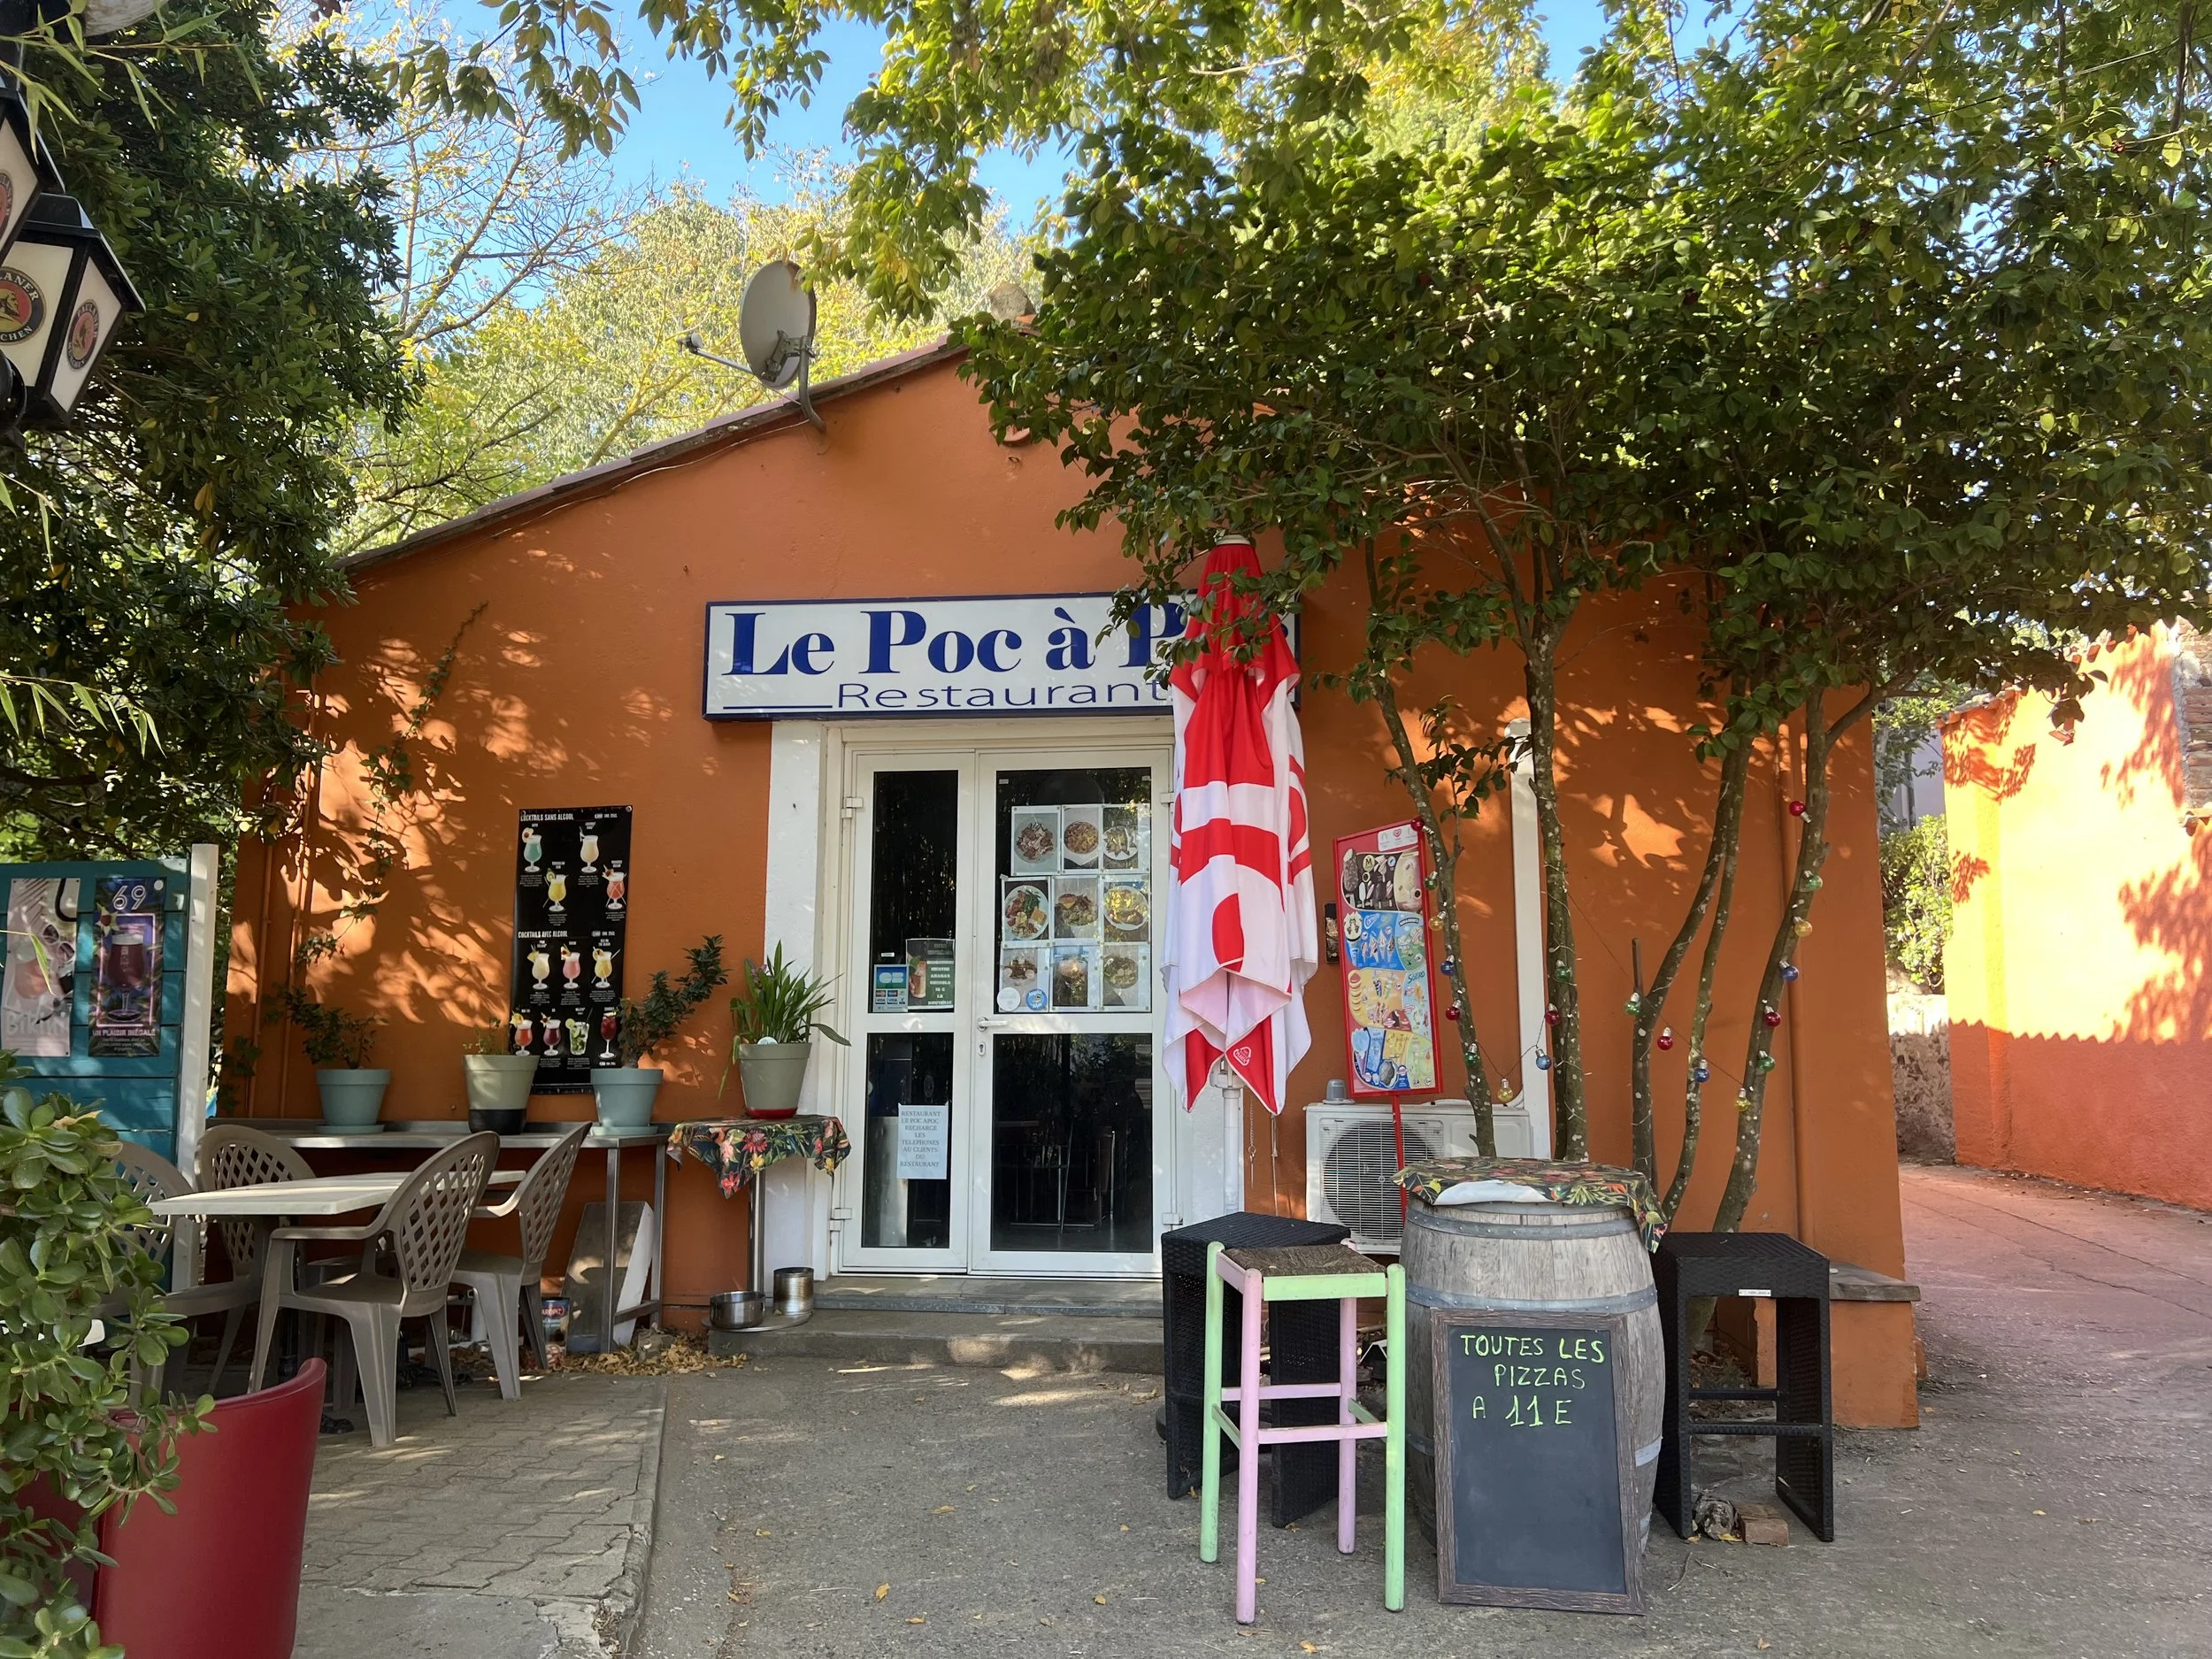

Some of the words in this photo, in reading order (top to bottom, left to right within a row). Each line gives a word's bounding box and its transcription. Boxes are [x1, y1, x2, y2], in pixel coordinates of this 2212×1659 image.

[721, 612, 835, 676] Le
[858, 610, 1023, 675] Poc
[1045, 607, 1096, 671] à
[837, 680, 1168, 708] Restaurant
[520, 813, 543, 822] COCKTAILS
[112, 885, 147, 910] 69
[1461, 1334, 1544, 1356] TOUTES
[1558, 1337, 1605, 1363] LES
[1494, 1363, 1586, 1389] PIZZAS
[1472, 1395, 1486, 1419] A
[1505, 1394, 1544, 1427] 11
[1555, 1399, 1572, 1425] E
